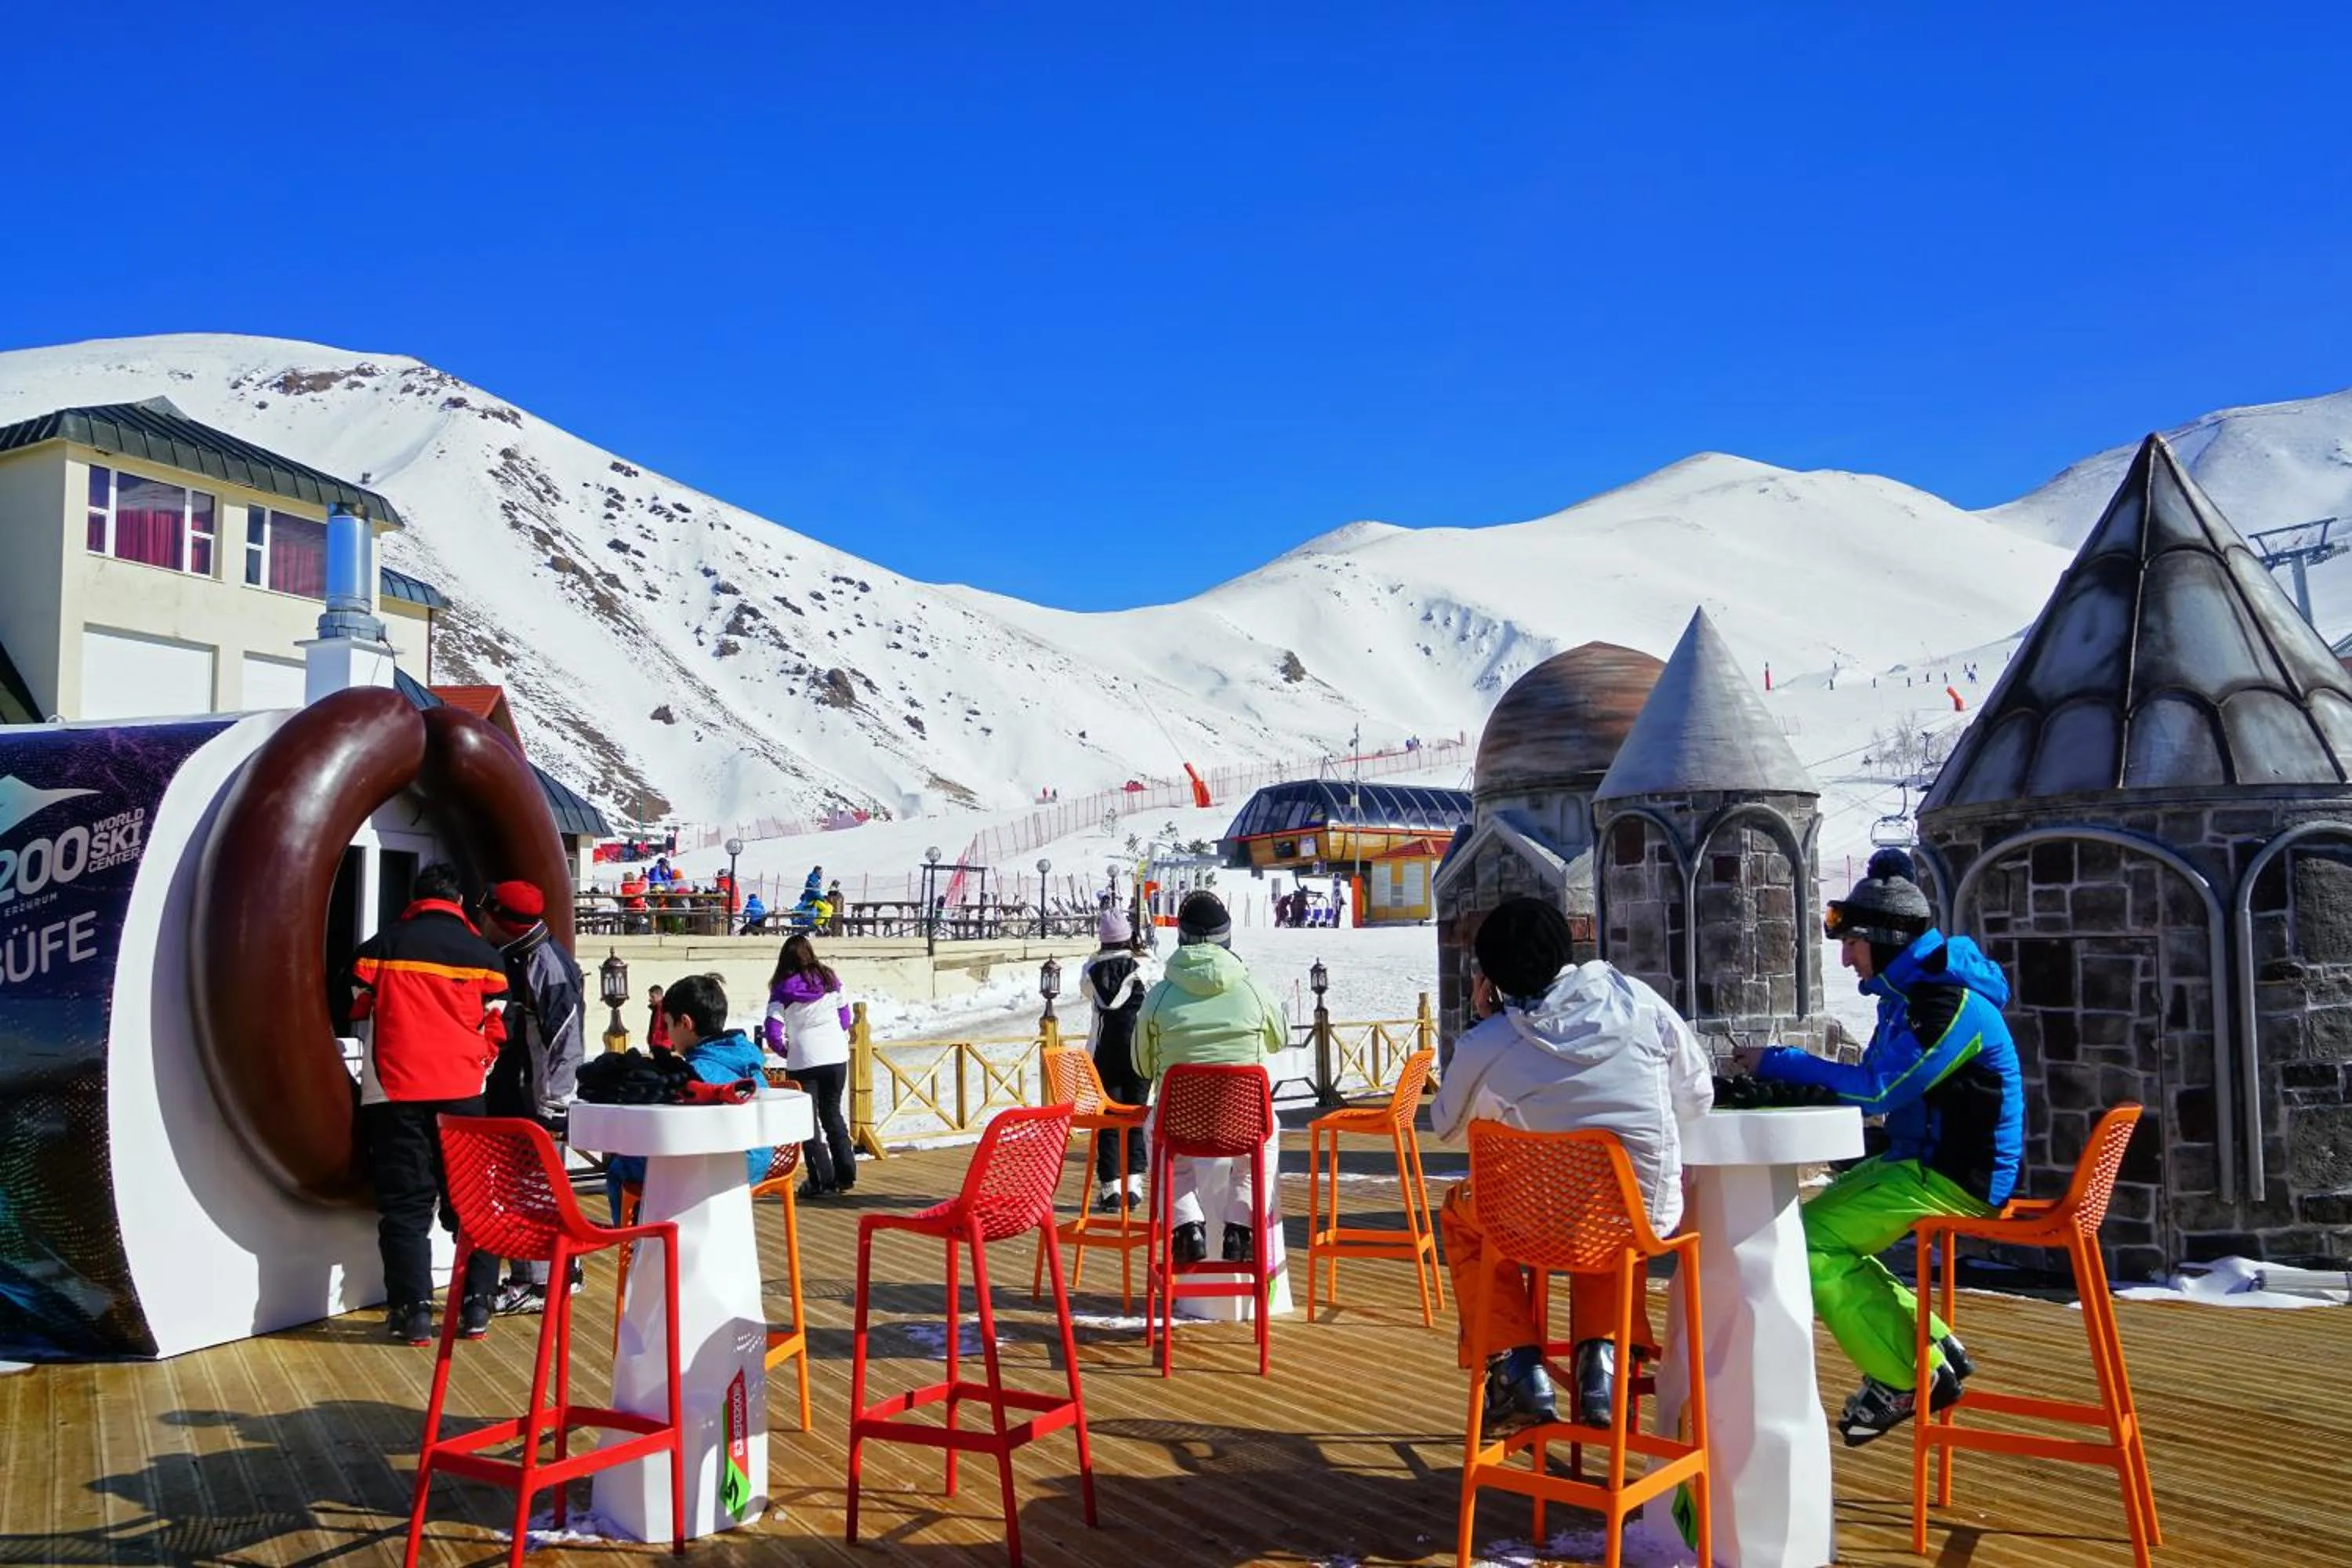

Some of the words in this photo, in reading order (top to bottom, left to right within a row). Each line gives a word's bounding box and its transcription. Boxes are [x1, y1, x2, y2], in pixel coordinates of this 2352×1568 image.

[93, 808, 145, 833] WORLD
[90, 821, 143, 859] SKI
[88, 847, 140, 873] CENTER
[4, 891, 57, 917] ERZURUM
[0, 909, 96, 985] ÜFE
